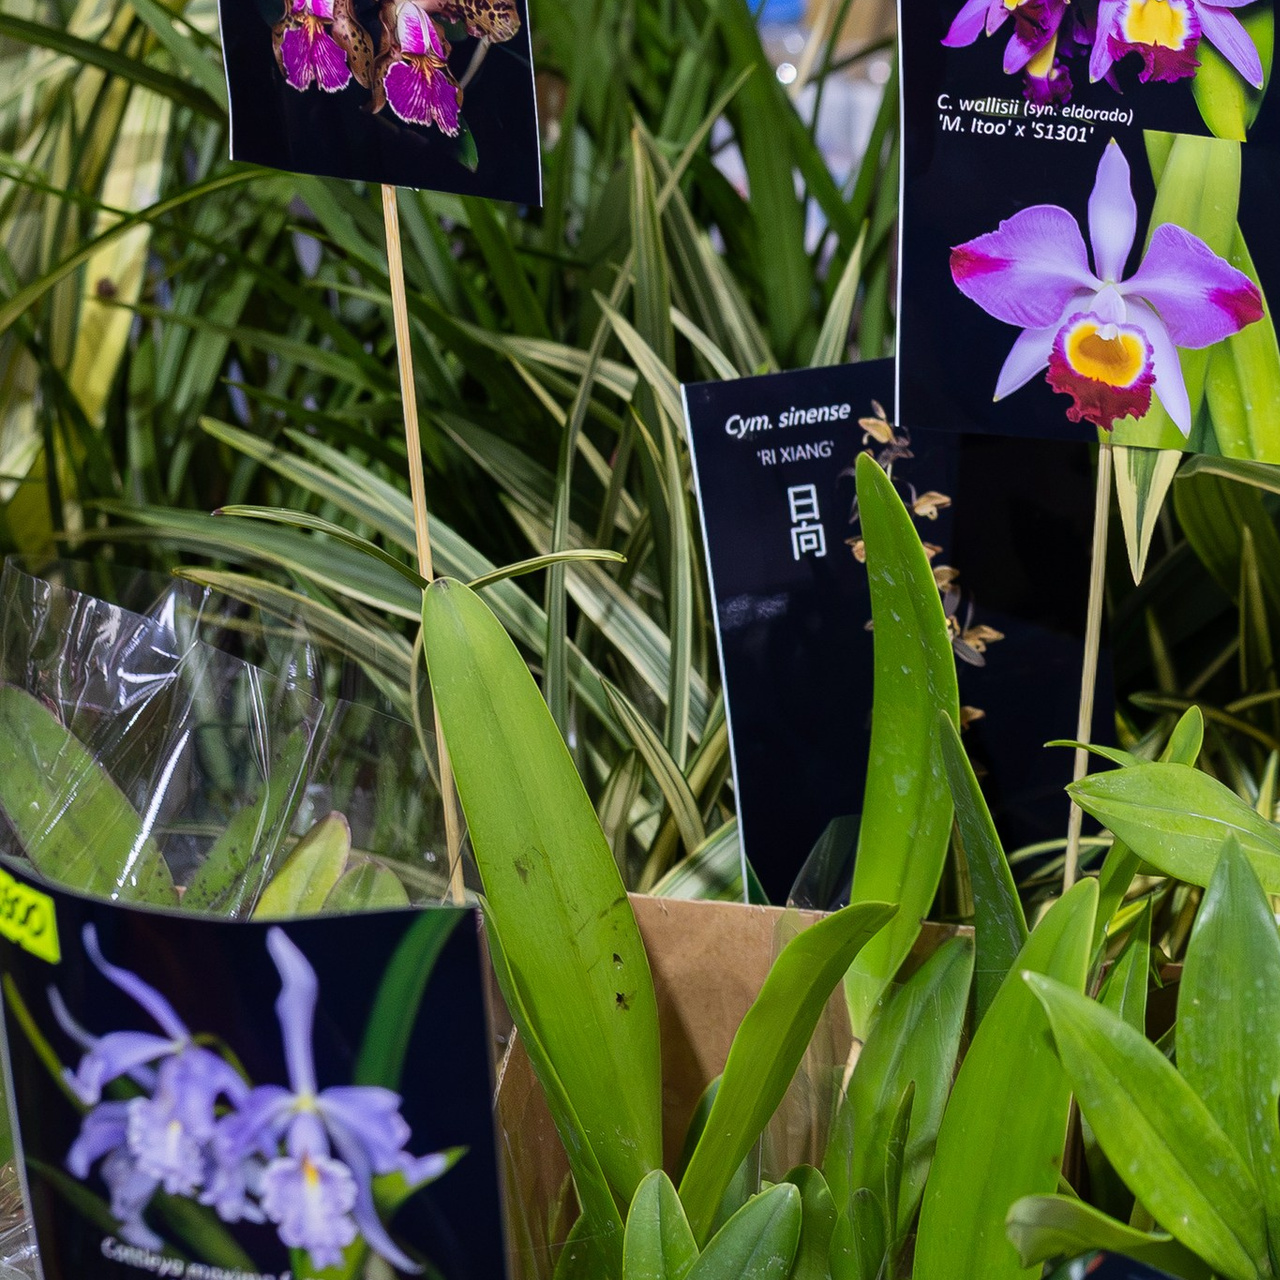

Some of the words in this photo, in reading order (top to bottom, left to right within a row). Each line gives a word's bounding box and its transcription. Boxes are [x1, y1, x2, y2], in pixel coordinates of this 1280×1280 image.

[937, 94, 953, 110] C.
[959, 97, 1020, 115] wallisii
[1023, 100, 1058, 118] (syn.
[1062, 104, 1134, 126] eldorado)
[938, 114, 965, 132] 'M.
[971, 118, 1012, 136] Itoo'
[1014, 124, 1026, 137] x
[1031, 121, 1095, 143] 'S1301'
[725, 414, 773, 439] Cym.
[778, 403, 851, 428] sinense
[757, 449, 777, 466] 'RI
[779, 440, 835, 464] XIANG'
[787, 483, 828, 561] 日向
